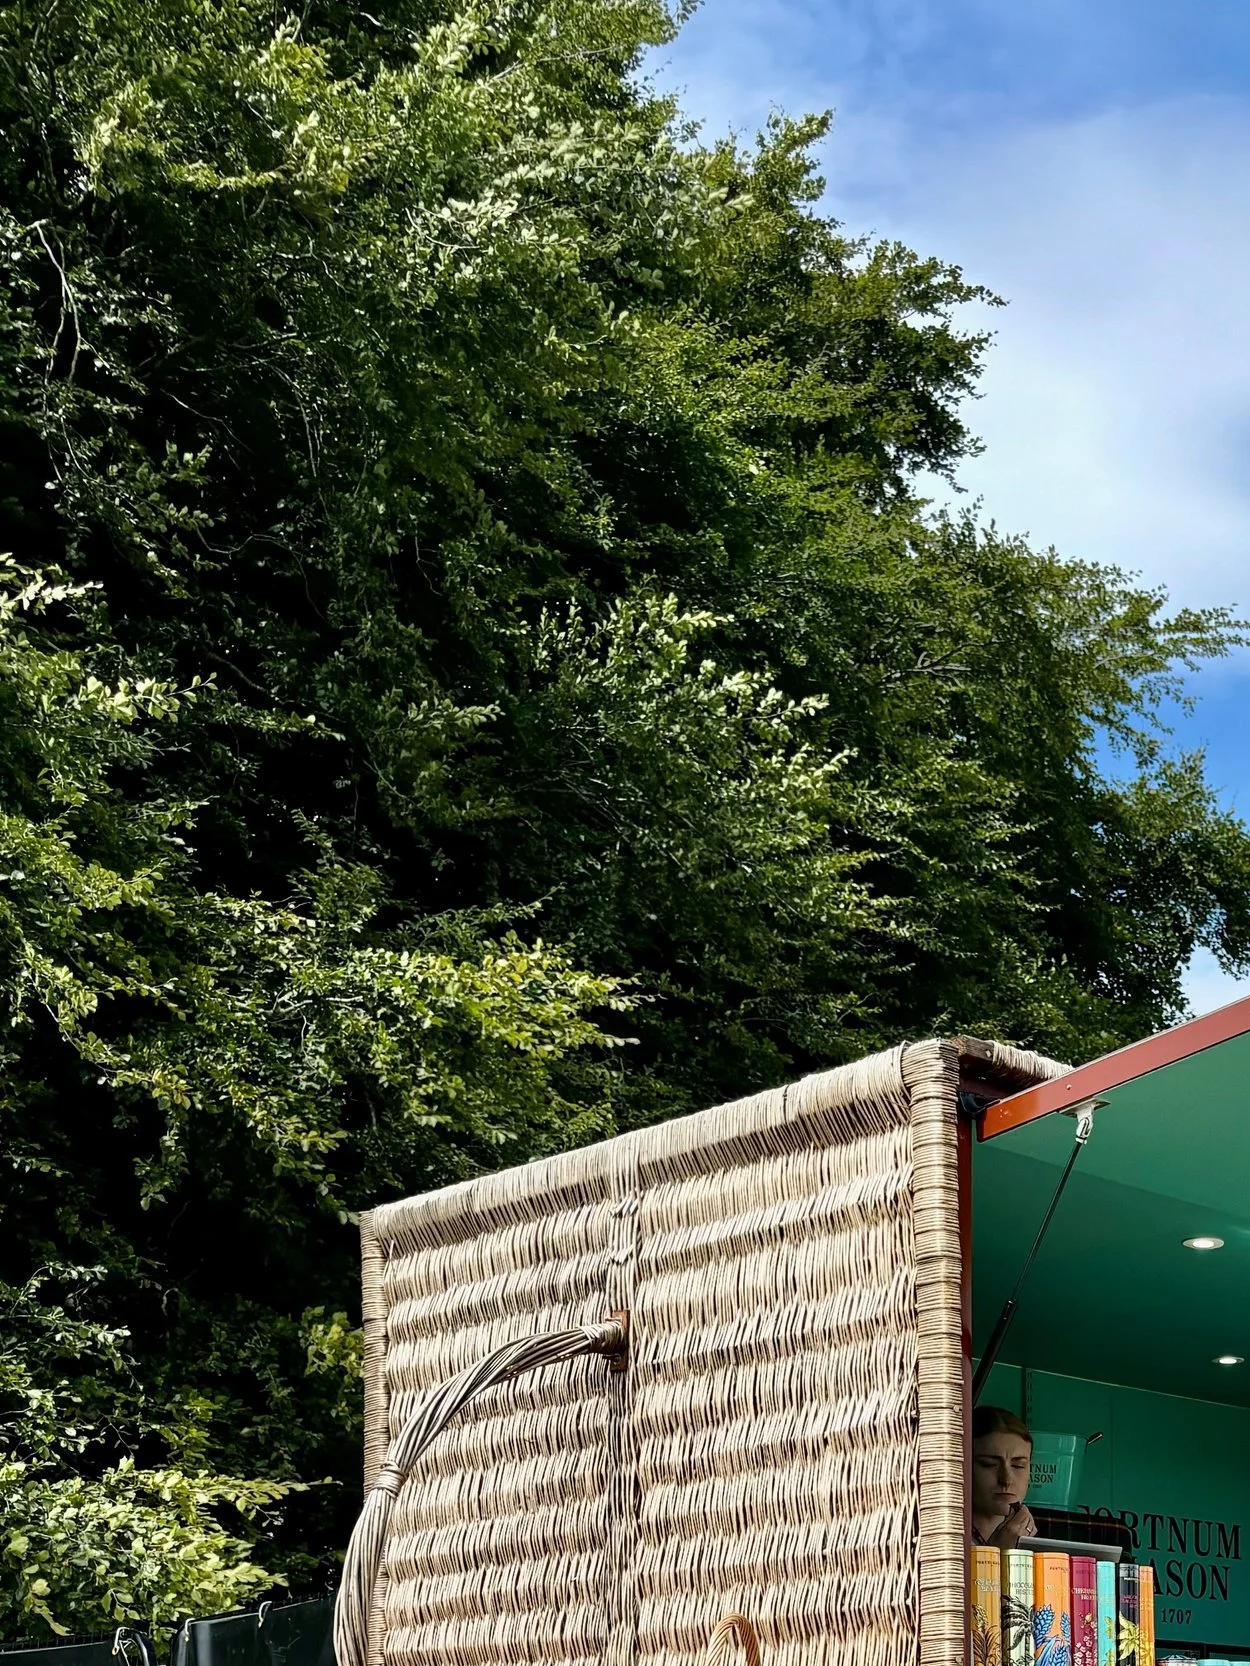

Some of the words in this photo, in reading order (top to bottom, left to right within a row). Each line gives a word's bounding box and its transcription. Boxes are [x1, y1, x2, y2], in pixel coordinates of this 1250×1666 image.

[1030, 1464, 1057, 1474] TNUM
[1029, 1473, 1054, 1483] ASON
[1078, 1505, 1242, 1560] RTNUM
[1133, 1556, 1230, 1601] ASON
[1161, 1608, 1192, 1625] 1707
